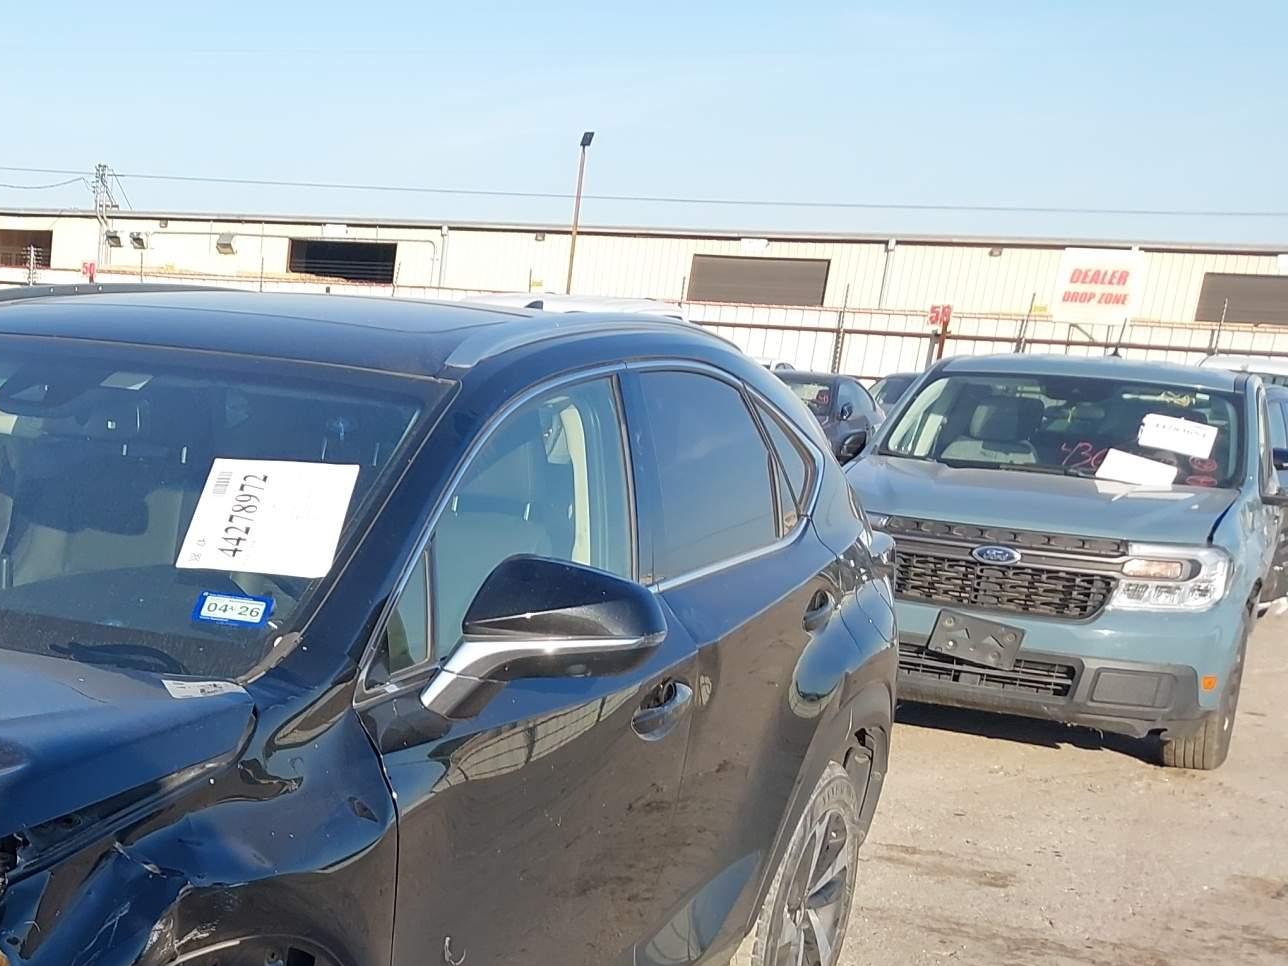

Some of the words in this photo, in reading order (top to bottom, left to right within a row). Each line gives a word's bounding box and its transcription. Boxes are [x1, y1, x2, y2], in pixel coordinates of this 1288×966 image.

[1069, 268, 1130, 286] DEALER
[1062, 291, 1097, 303] DROP
[1097, 293, 1130, 305] ZONE
[217, 473, 269, 558] 44278972
[206, 601, 229, 613] 04
[237, 605, 261, 618] 26
